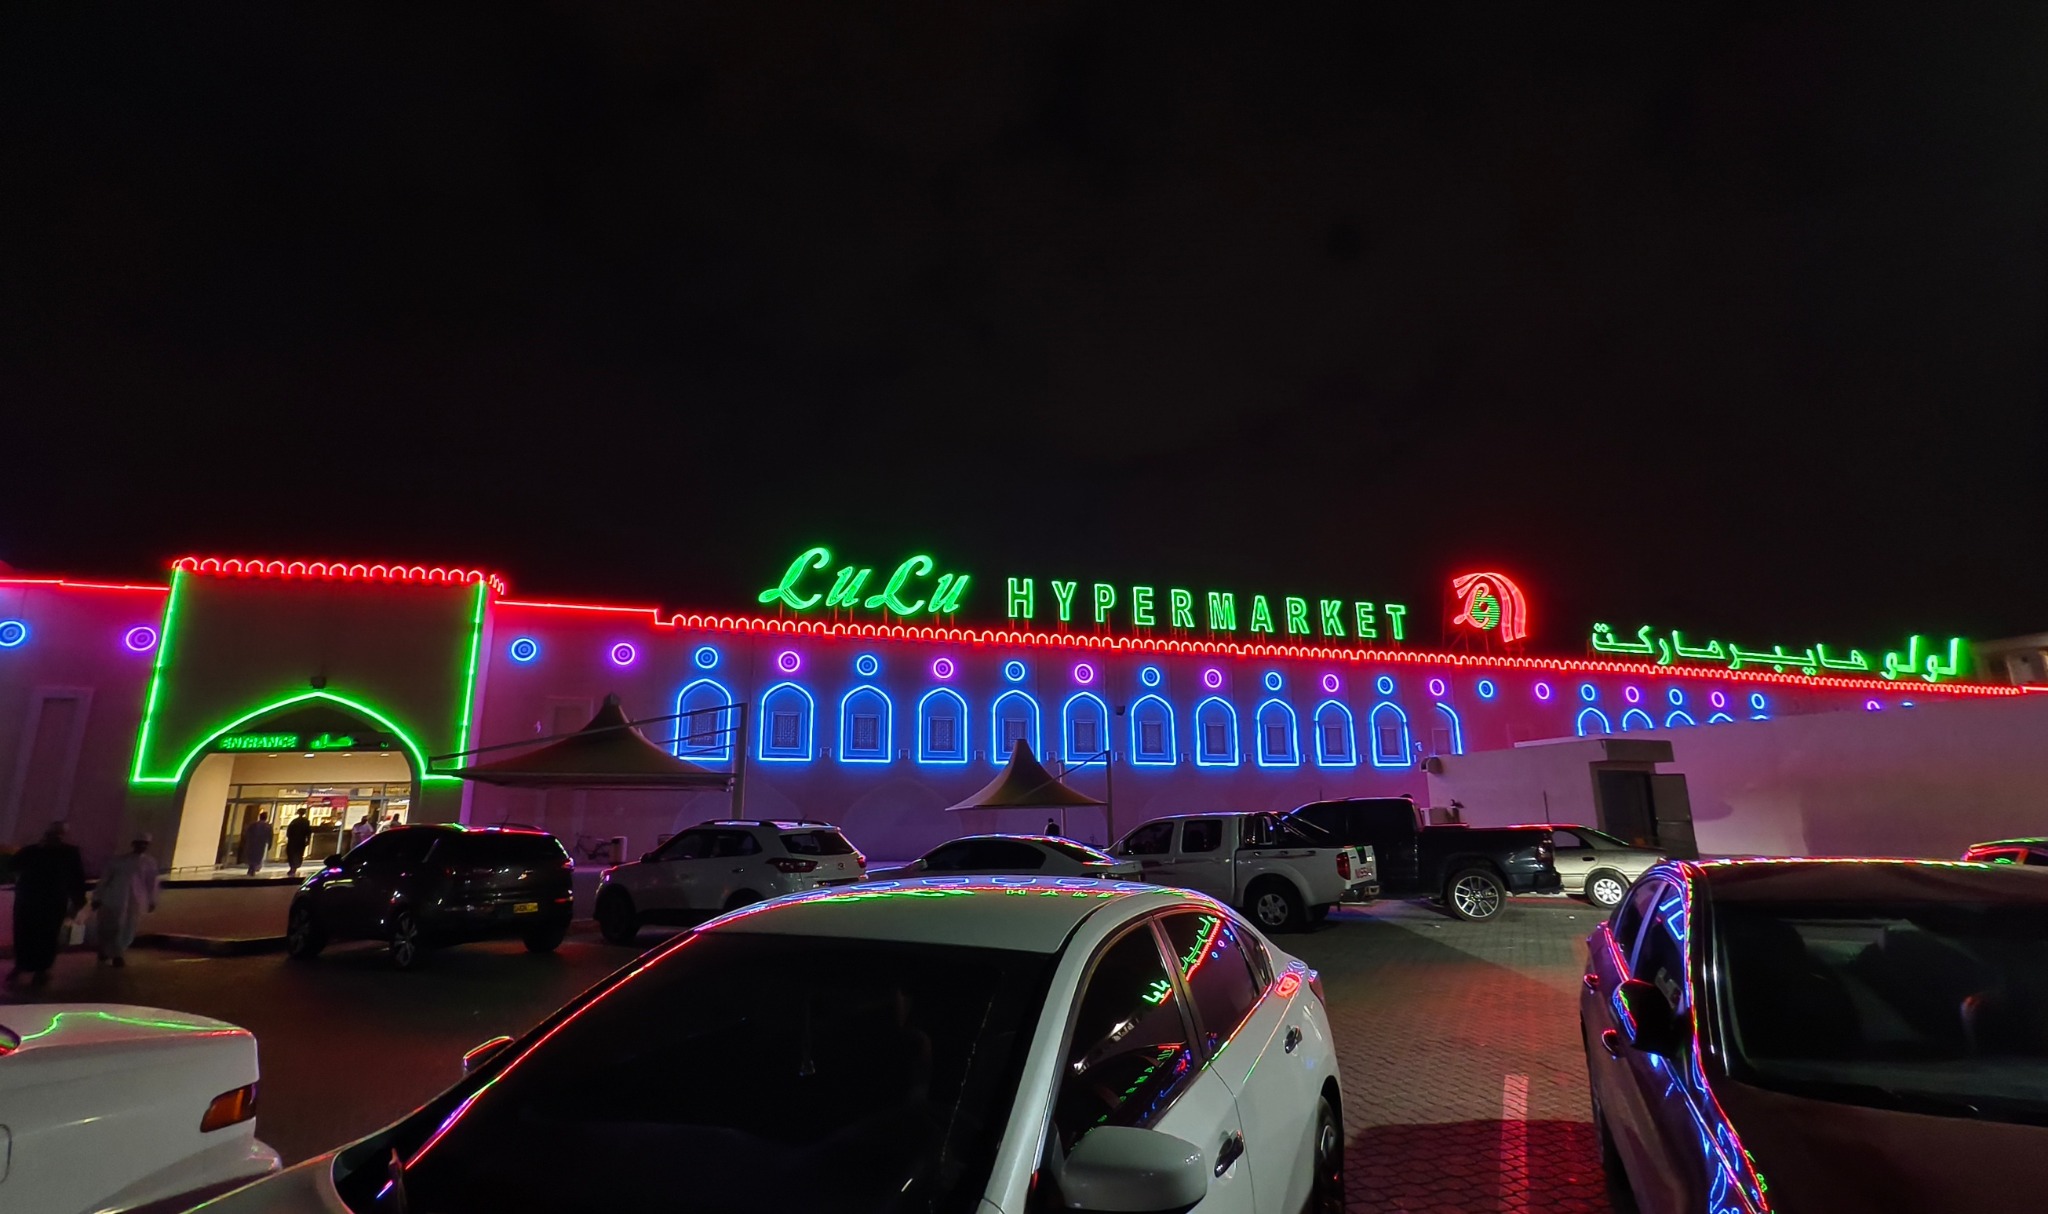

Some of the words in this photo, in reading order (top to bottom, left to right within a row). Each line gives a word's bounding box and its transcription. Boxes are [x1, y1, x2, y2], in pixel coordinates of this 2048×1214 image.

[758, 547, 970, 616] LuLu
[1007, 577, 1406, 640] HYPERMARKET
[1880, 635, 1960, 683] لولو
[222, 735, 298, 749] ENTRANCE
